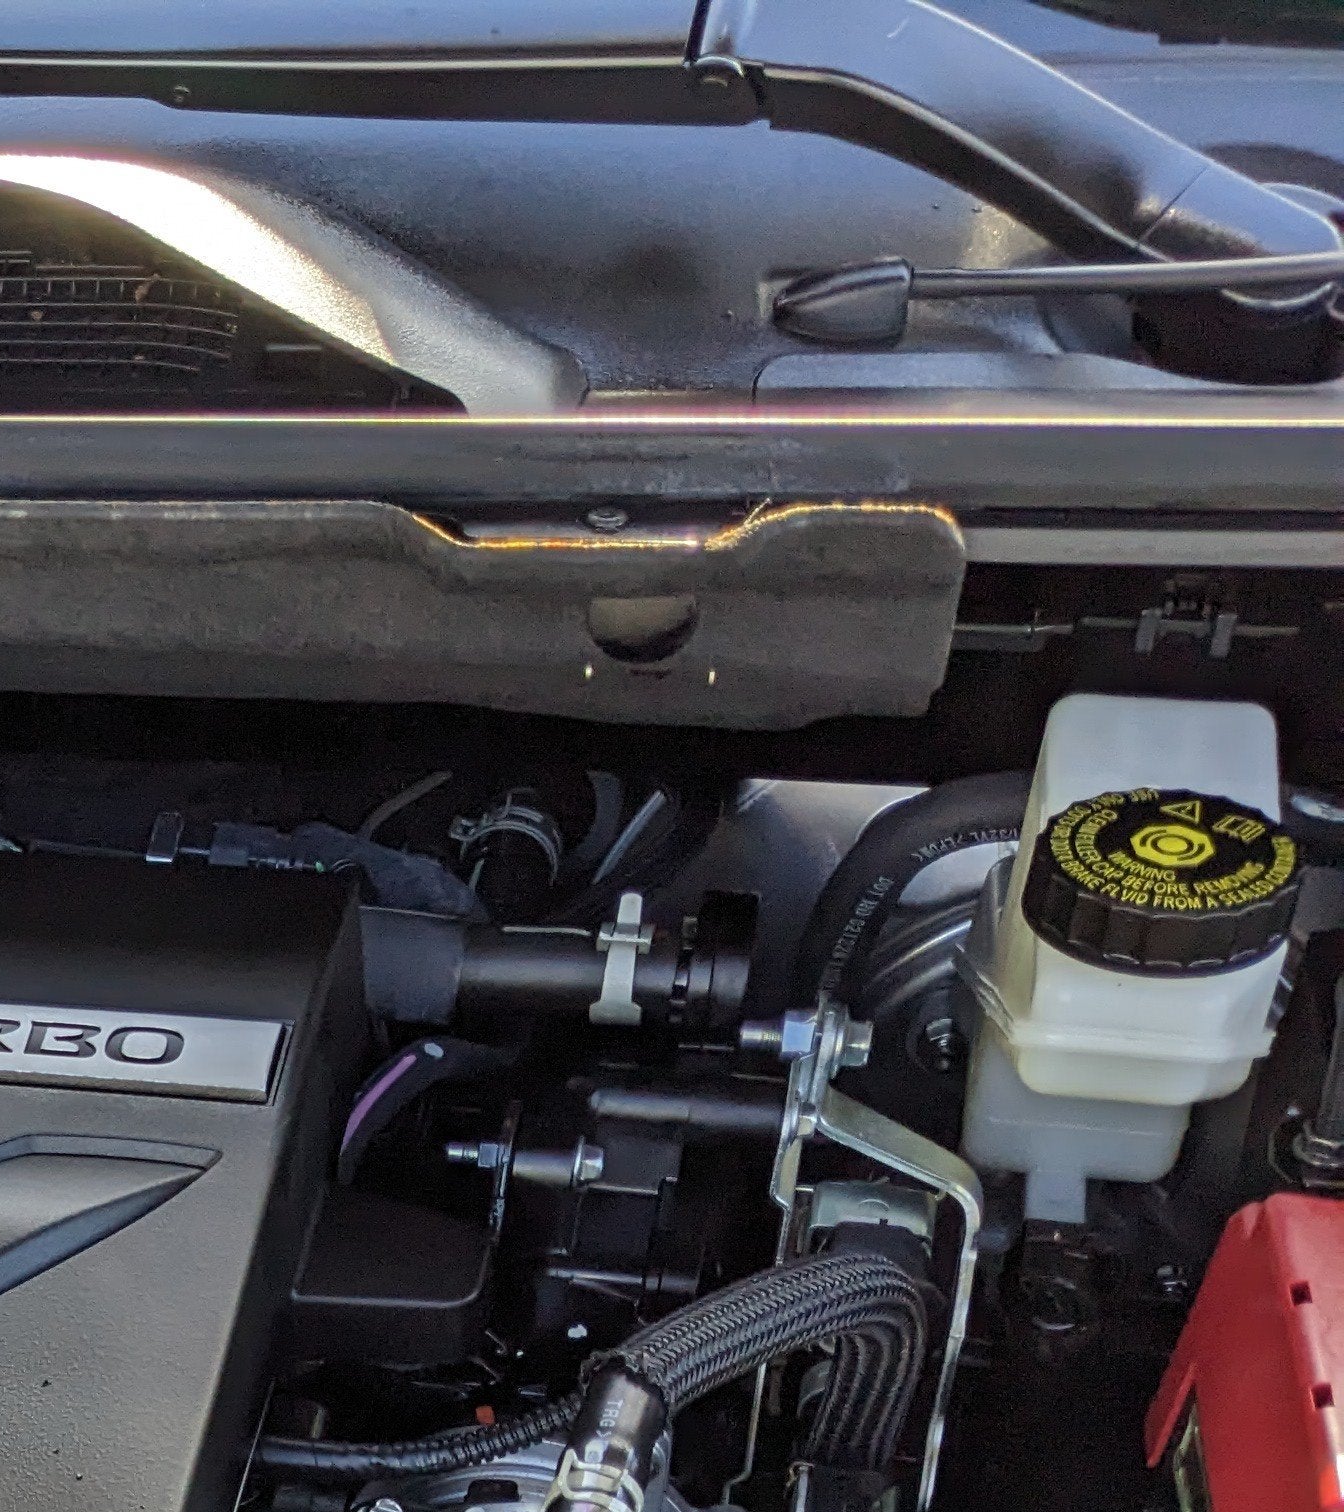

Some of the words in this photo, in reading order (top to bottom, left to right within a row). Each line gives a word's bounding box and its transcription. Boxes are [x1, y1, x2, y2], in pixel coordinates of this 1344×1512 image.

[1108, 851, 1177, 882] WARNING
[1121, 875, 1191, 896] BEFORE
[1153, 895, 1201, 911] FROM
[1207, 896, 1219, 909] A
